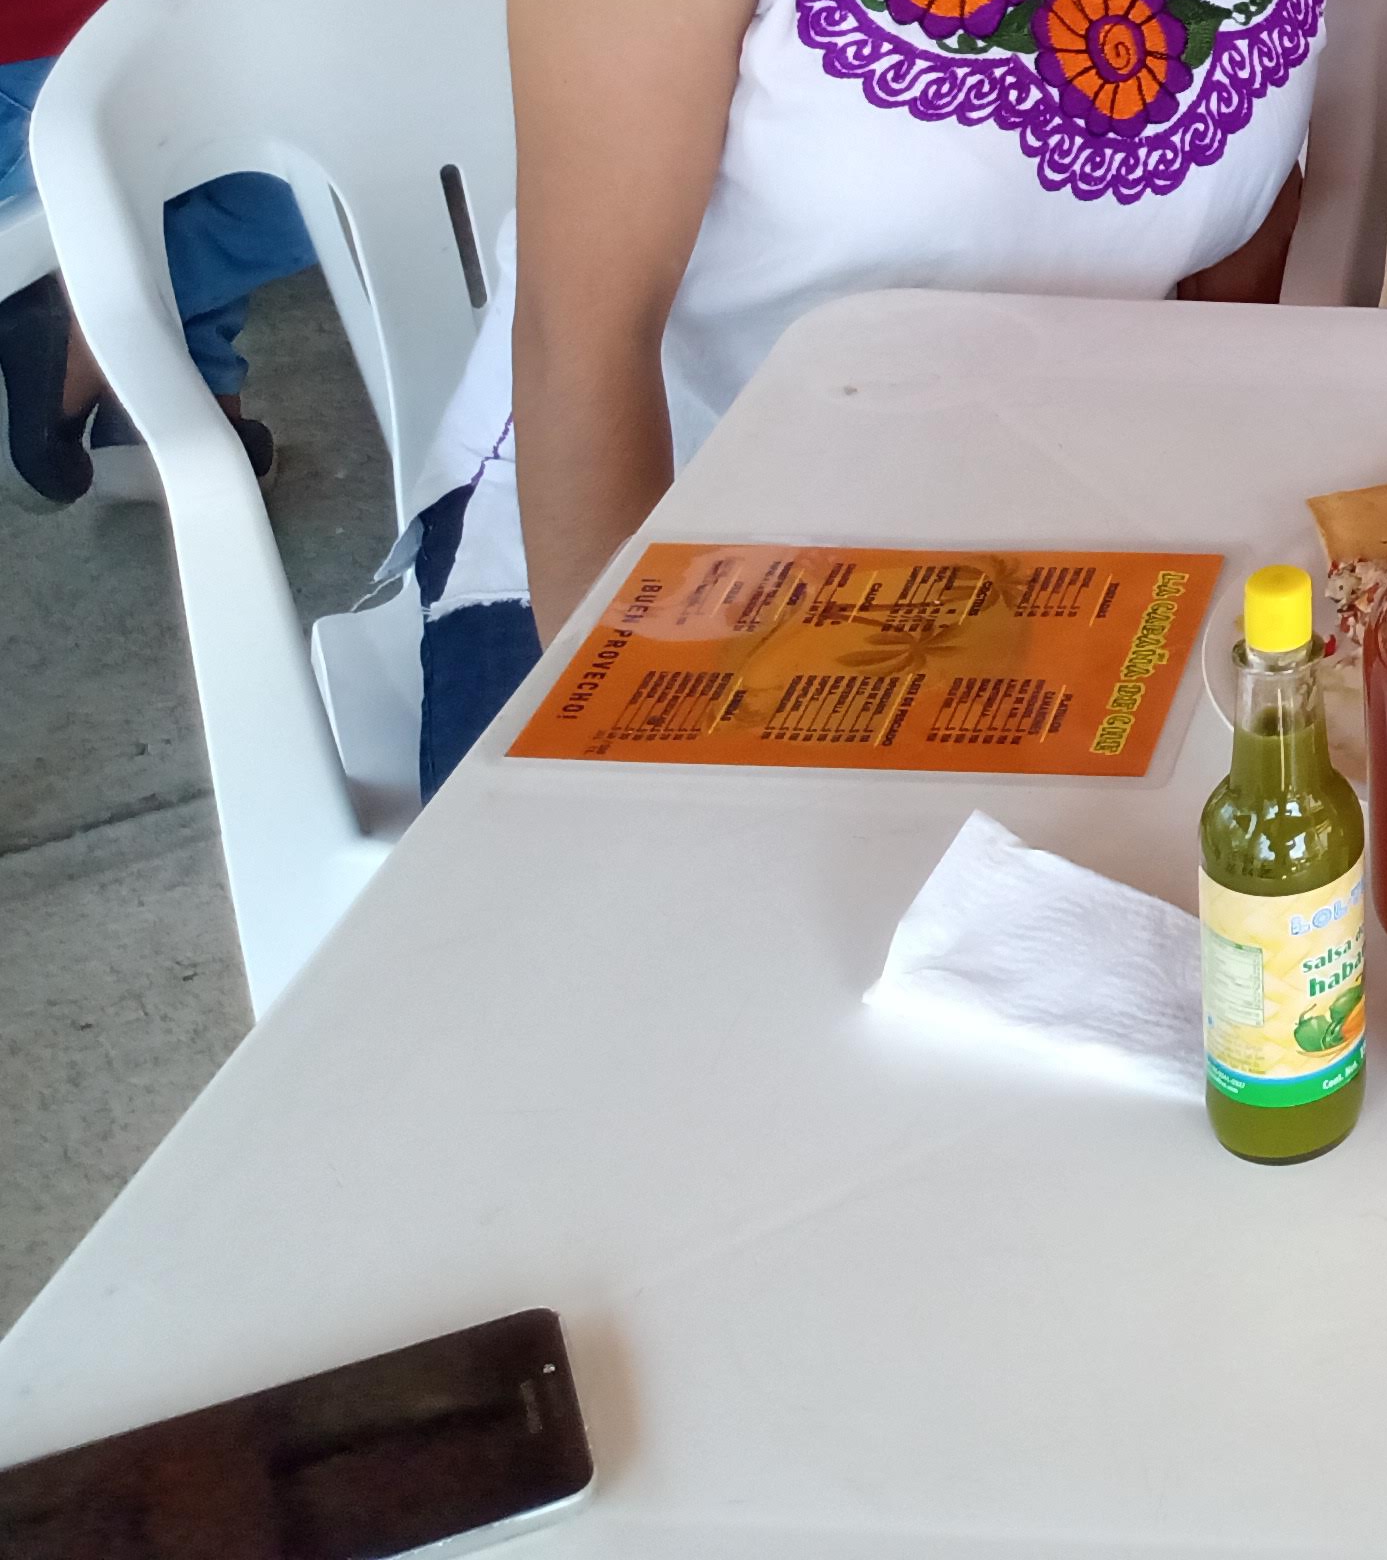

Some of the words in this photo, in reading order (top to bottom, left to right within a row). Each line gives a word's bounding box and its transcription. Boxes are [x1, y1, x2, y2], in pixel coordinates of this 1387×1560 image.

[1153, 571, 1188, 598] LA
[557, 629, 632, 719] PROVECHO!
[1109, 682, 1145, 711] DE
[1302, 939, 1352, 973] salsa
[1309, 945, 1364, 998] haba
